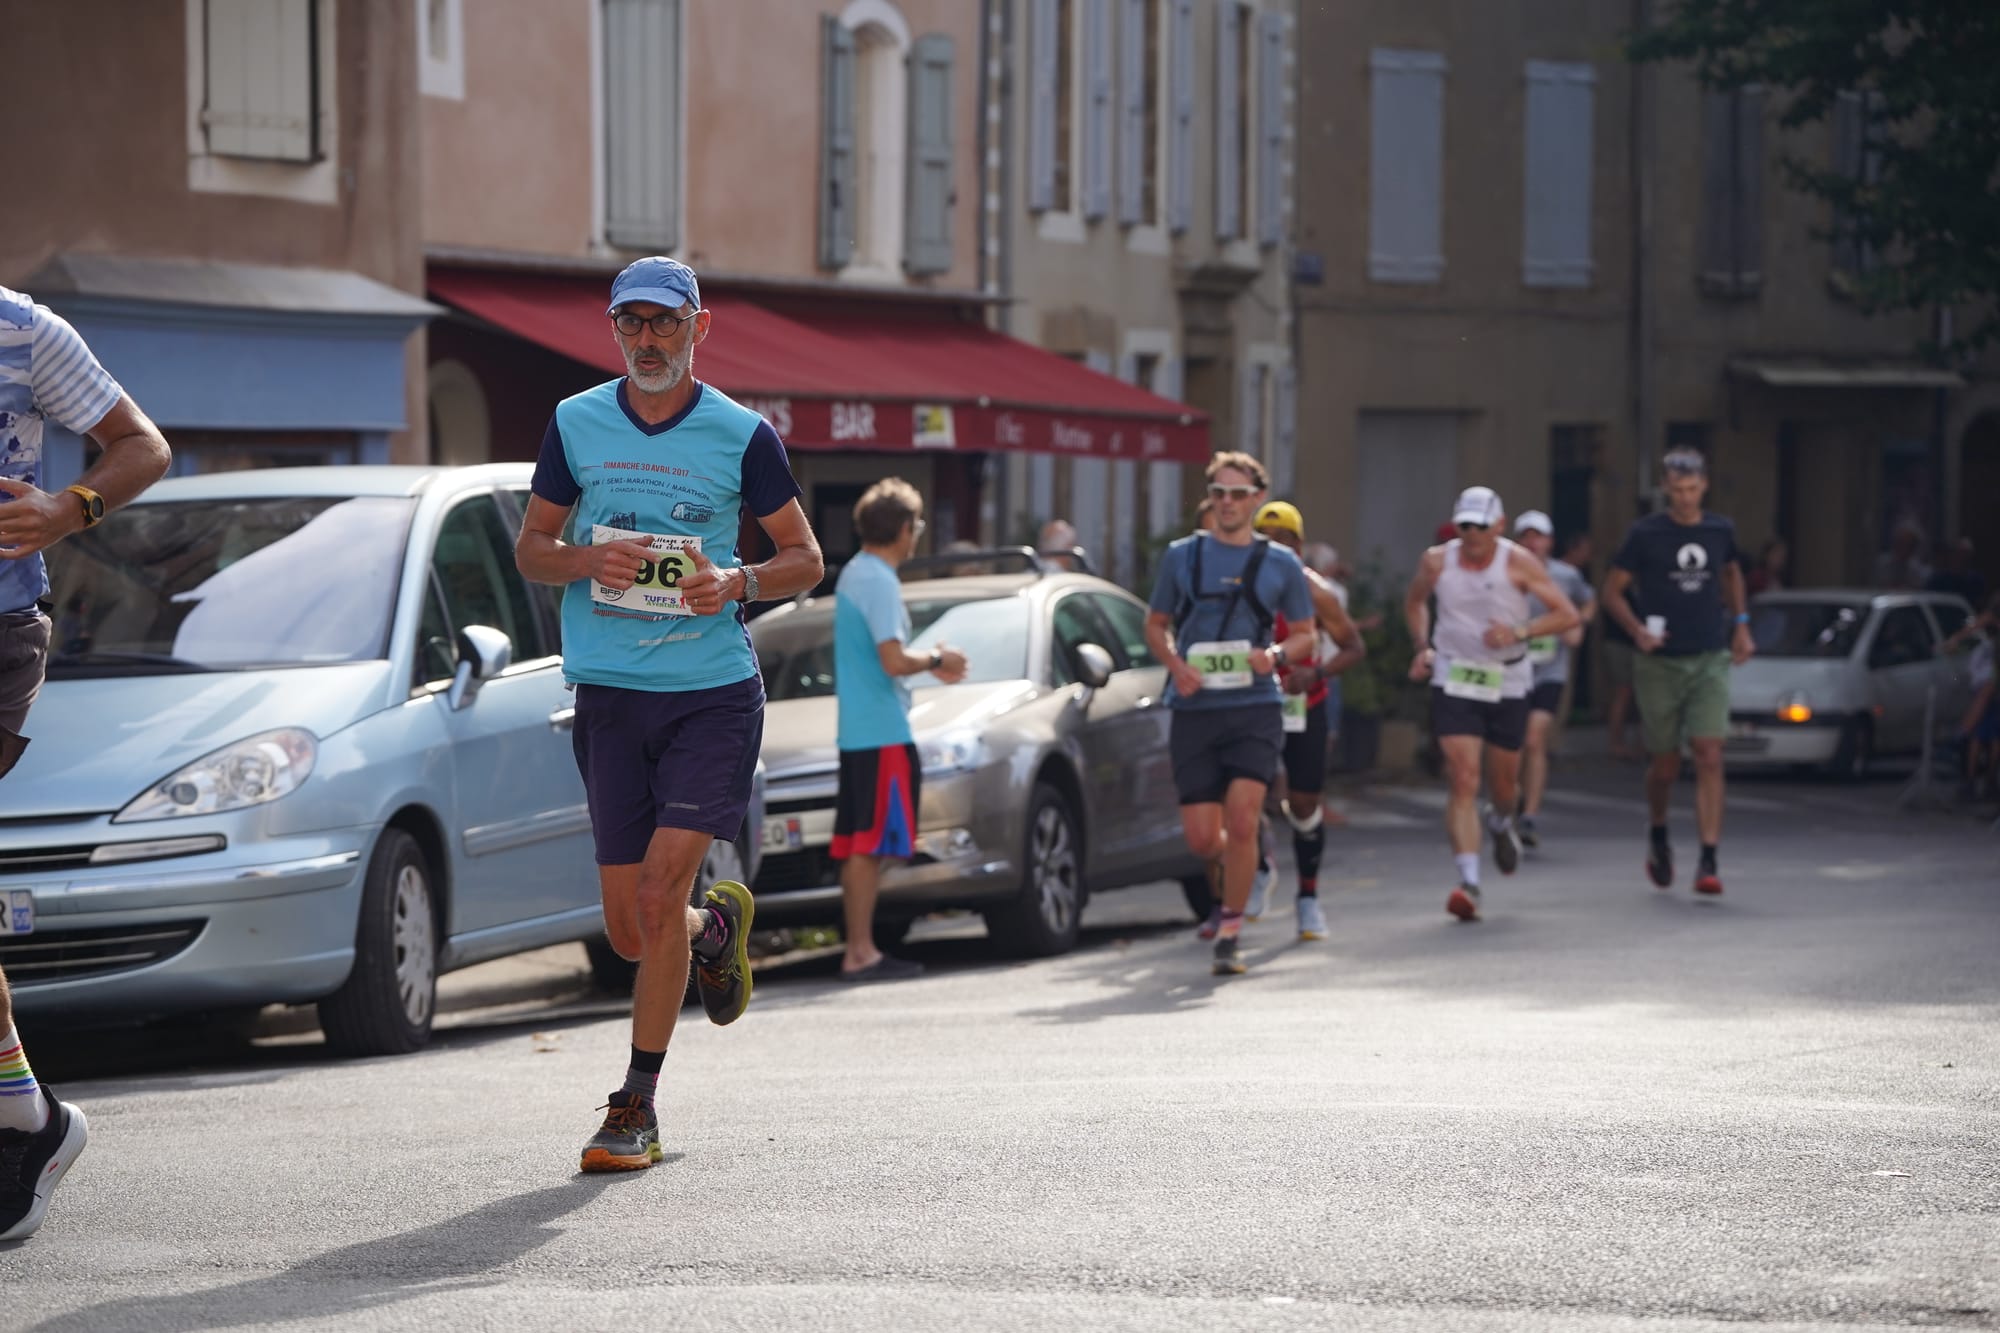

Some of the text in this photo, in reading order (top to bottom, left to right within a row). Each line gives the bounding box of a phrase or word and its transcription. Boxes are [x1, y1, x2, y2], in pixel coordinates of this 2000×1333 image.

[831, 402, 876, 440] BAR
[603, 461, 690, 477] DIMANCHE 30 AVRIL 2017
[607, 477, 665, 488] SEMI-MARATHON
[671, 484, 711, 500] MARATHON
[647, 489, 673, 499] DISTANCE
[684, 505, 713, 514] Marathon
[644, 594, 677, 604] TUFF'S
[1204, 655, 1234, 673] 30
[1464, 668, 1487, 685] 72
